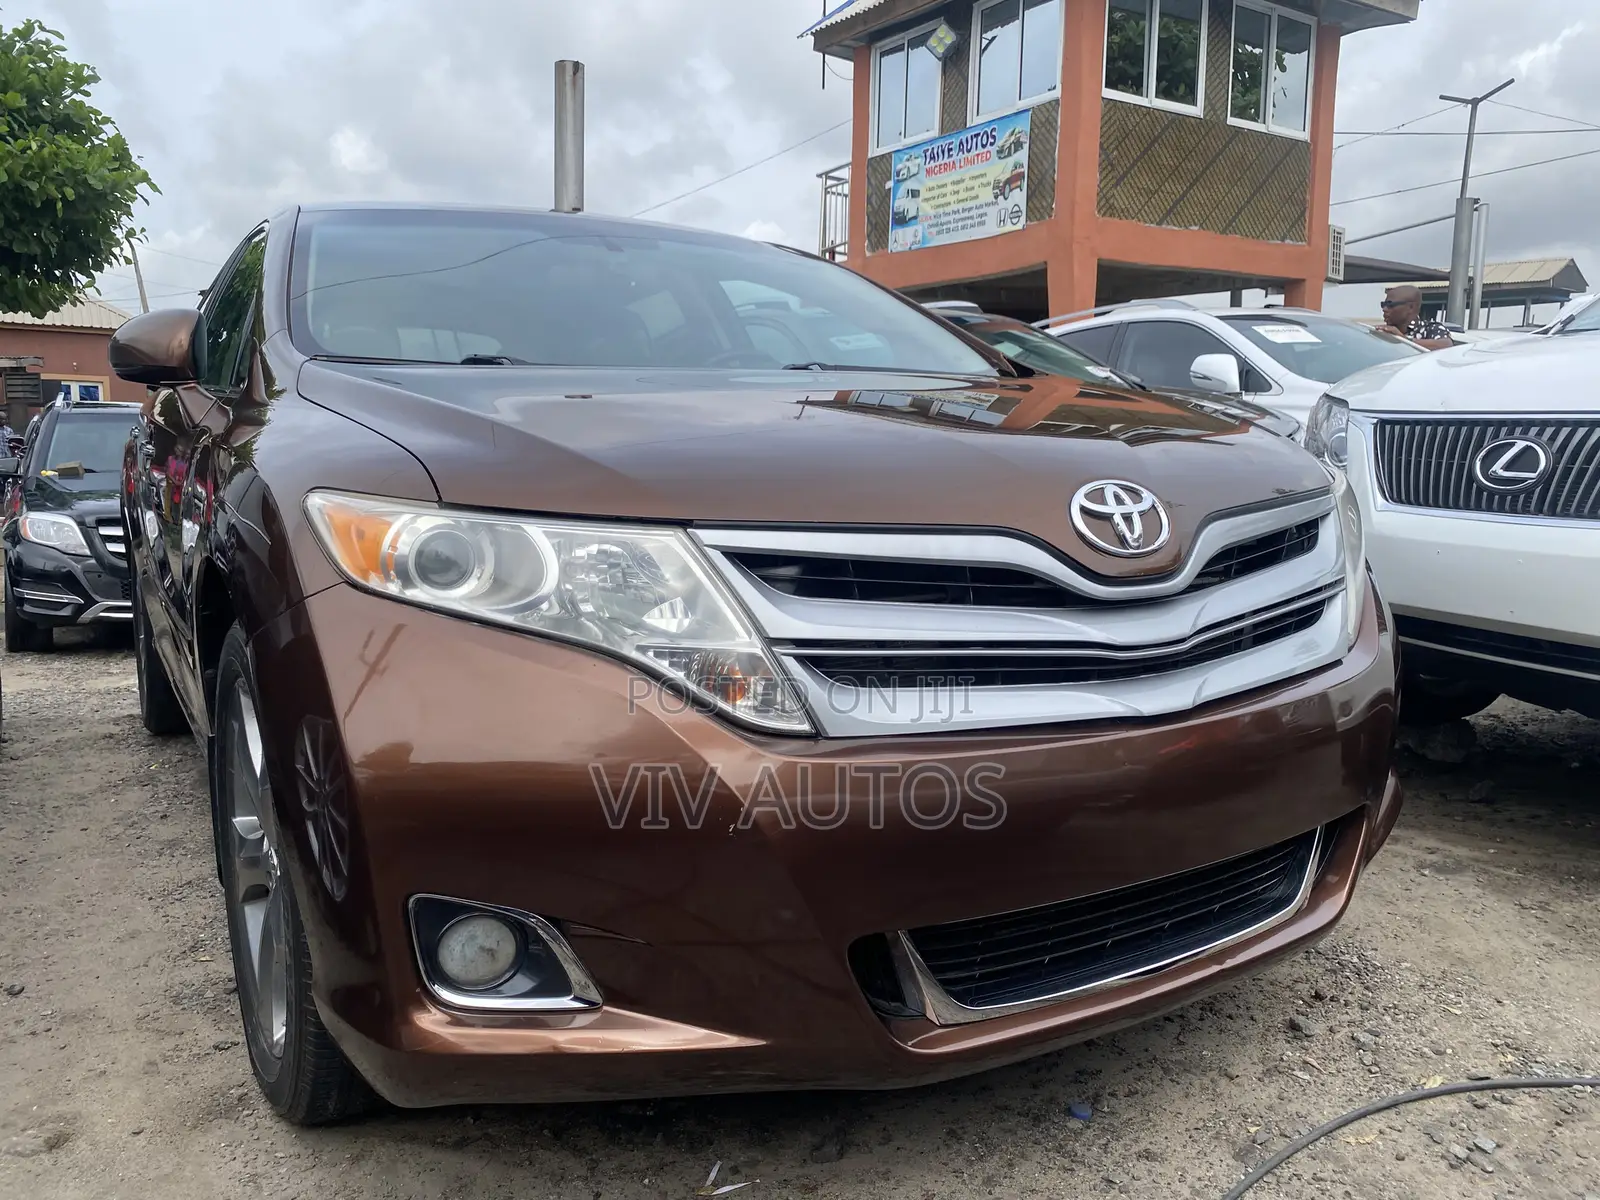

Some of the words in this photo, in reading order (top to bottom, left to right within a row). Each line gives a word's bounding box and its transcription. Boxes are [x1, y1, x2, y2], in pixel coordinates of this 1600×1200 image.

[922, 140, 954, 166] TAIYE
[956, 126, 997, 157] AUTOS
[925, 161, 957, 178] NIGERIA
[959, 150, 992, 169] LIMITED
